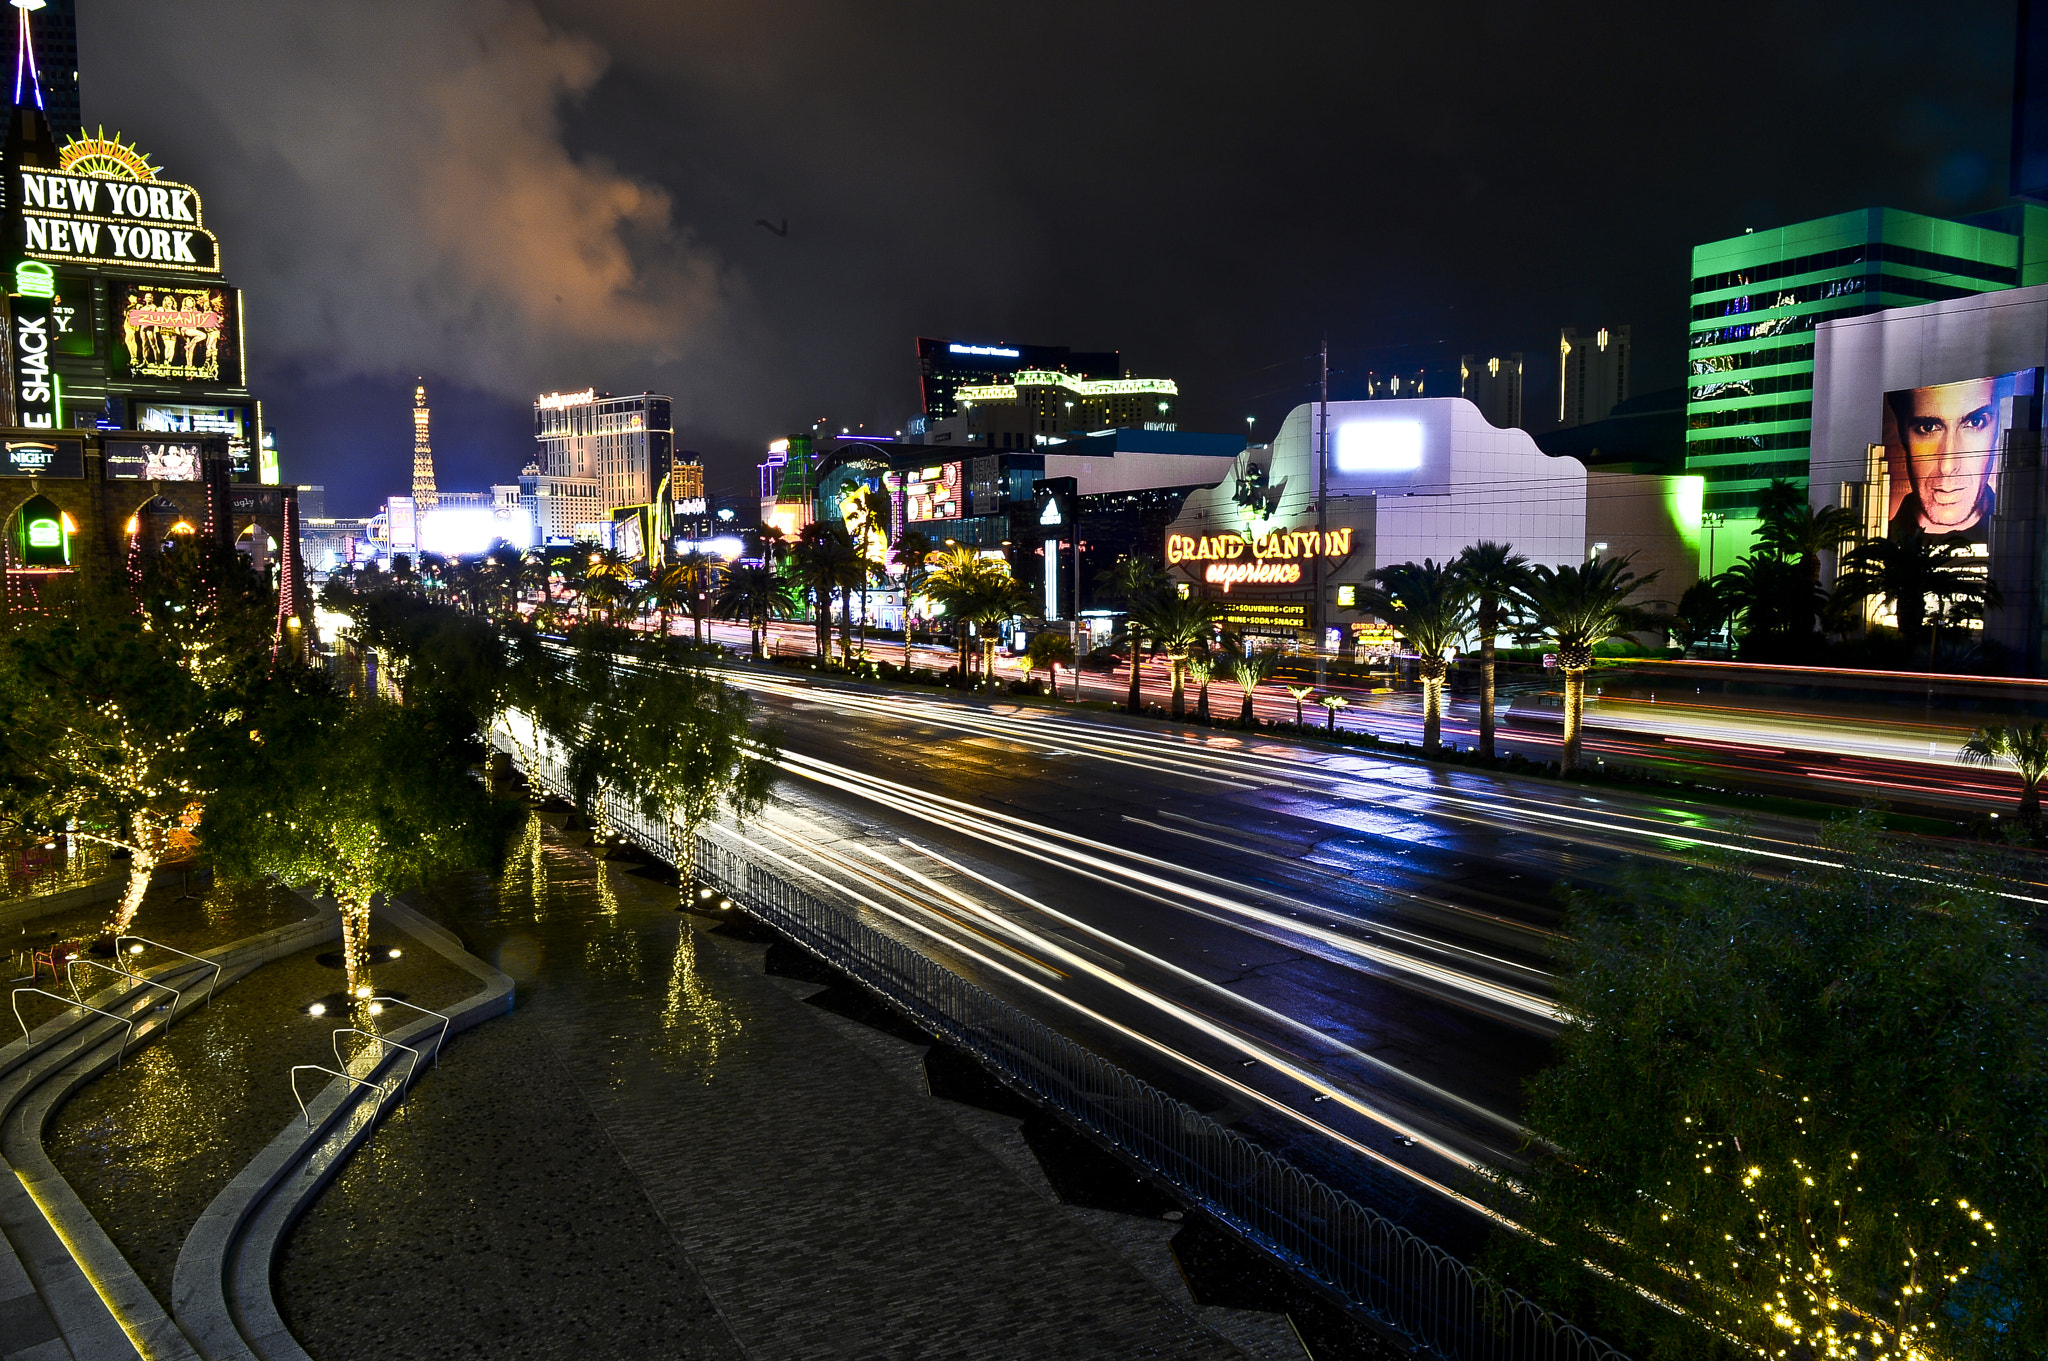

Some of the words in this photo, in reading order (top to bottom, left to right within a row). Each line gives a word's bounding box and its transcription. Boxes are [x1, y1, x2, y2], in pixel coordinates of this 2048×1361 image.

[22, 173, 99, 212] NEW
[105, 182, 195, 222] YORK
[25, 216, 100, 254] NEW
[107, 224, 197, 263] YORK
[63, 307, 75, 315] TO
[138, 311, 210, 327] ZUMANITY
[18, 315, 51, 403] SHACK
[141, 368, 171, 378] CIRQUE
[539, 387, 594, 412] hollywood
[9, 452, 54, 464] NIGHT
[233, 497, 255, 508] ugly
[1167, 533, 1246, 564] GRAND
[1252, 528, 1354, 560] CANYON
[1205, 559, 1301, 593] experience
[1239, 604, 1279, 614] SOUVENIRS
[1283, 606, 1304, 614] GIFTS
[1227, 615, 1247, 624] WINE
[1250, 617, 1270, 625] SODA
[1274, 617, 1304, 627] SNACKS
